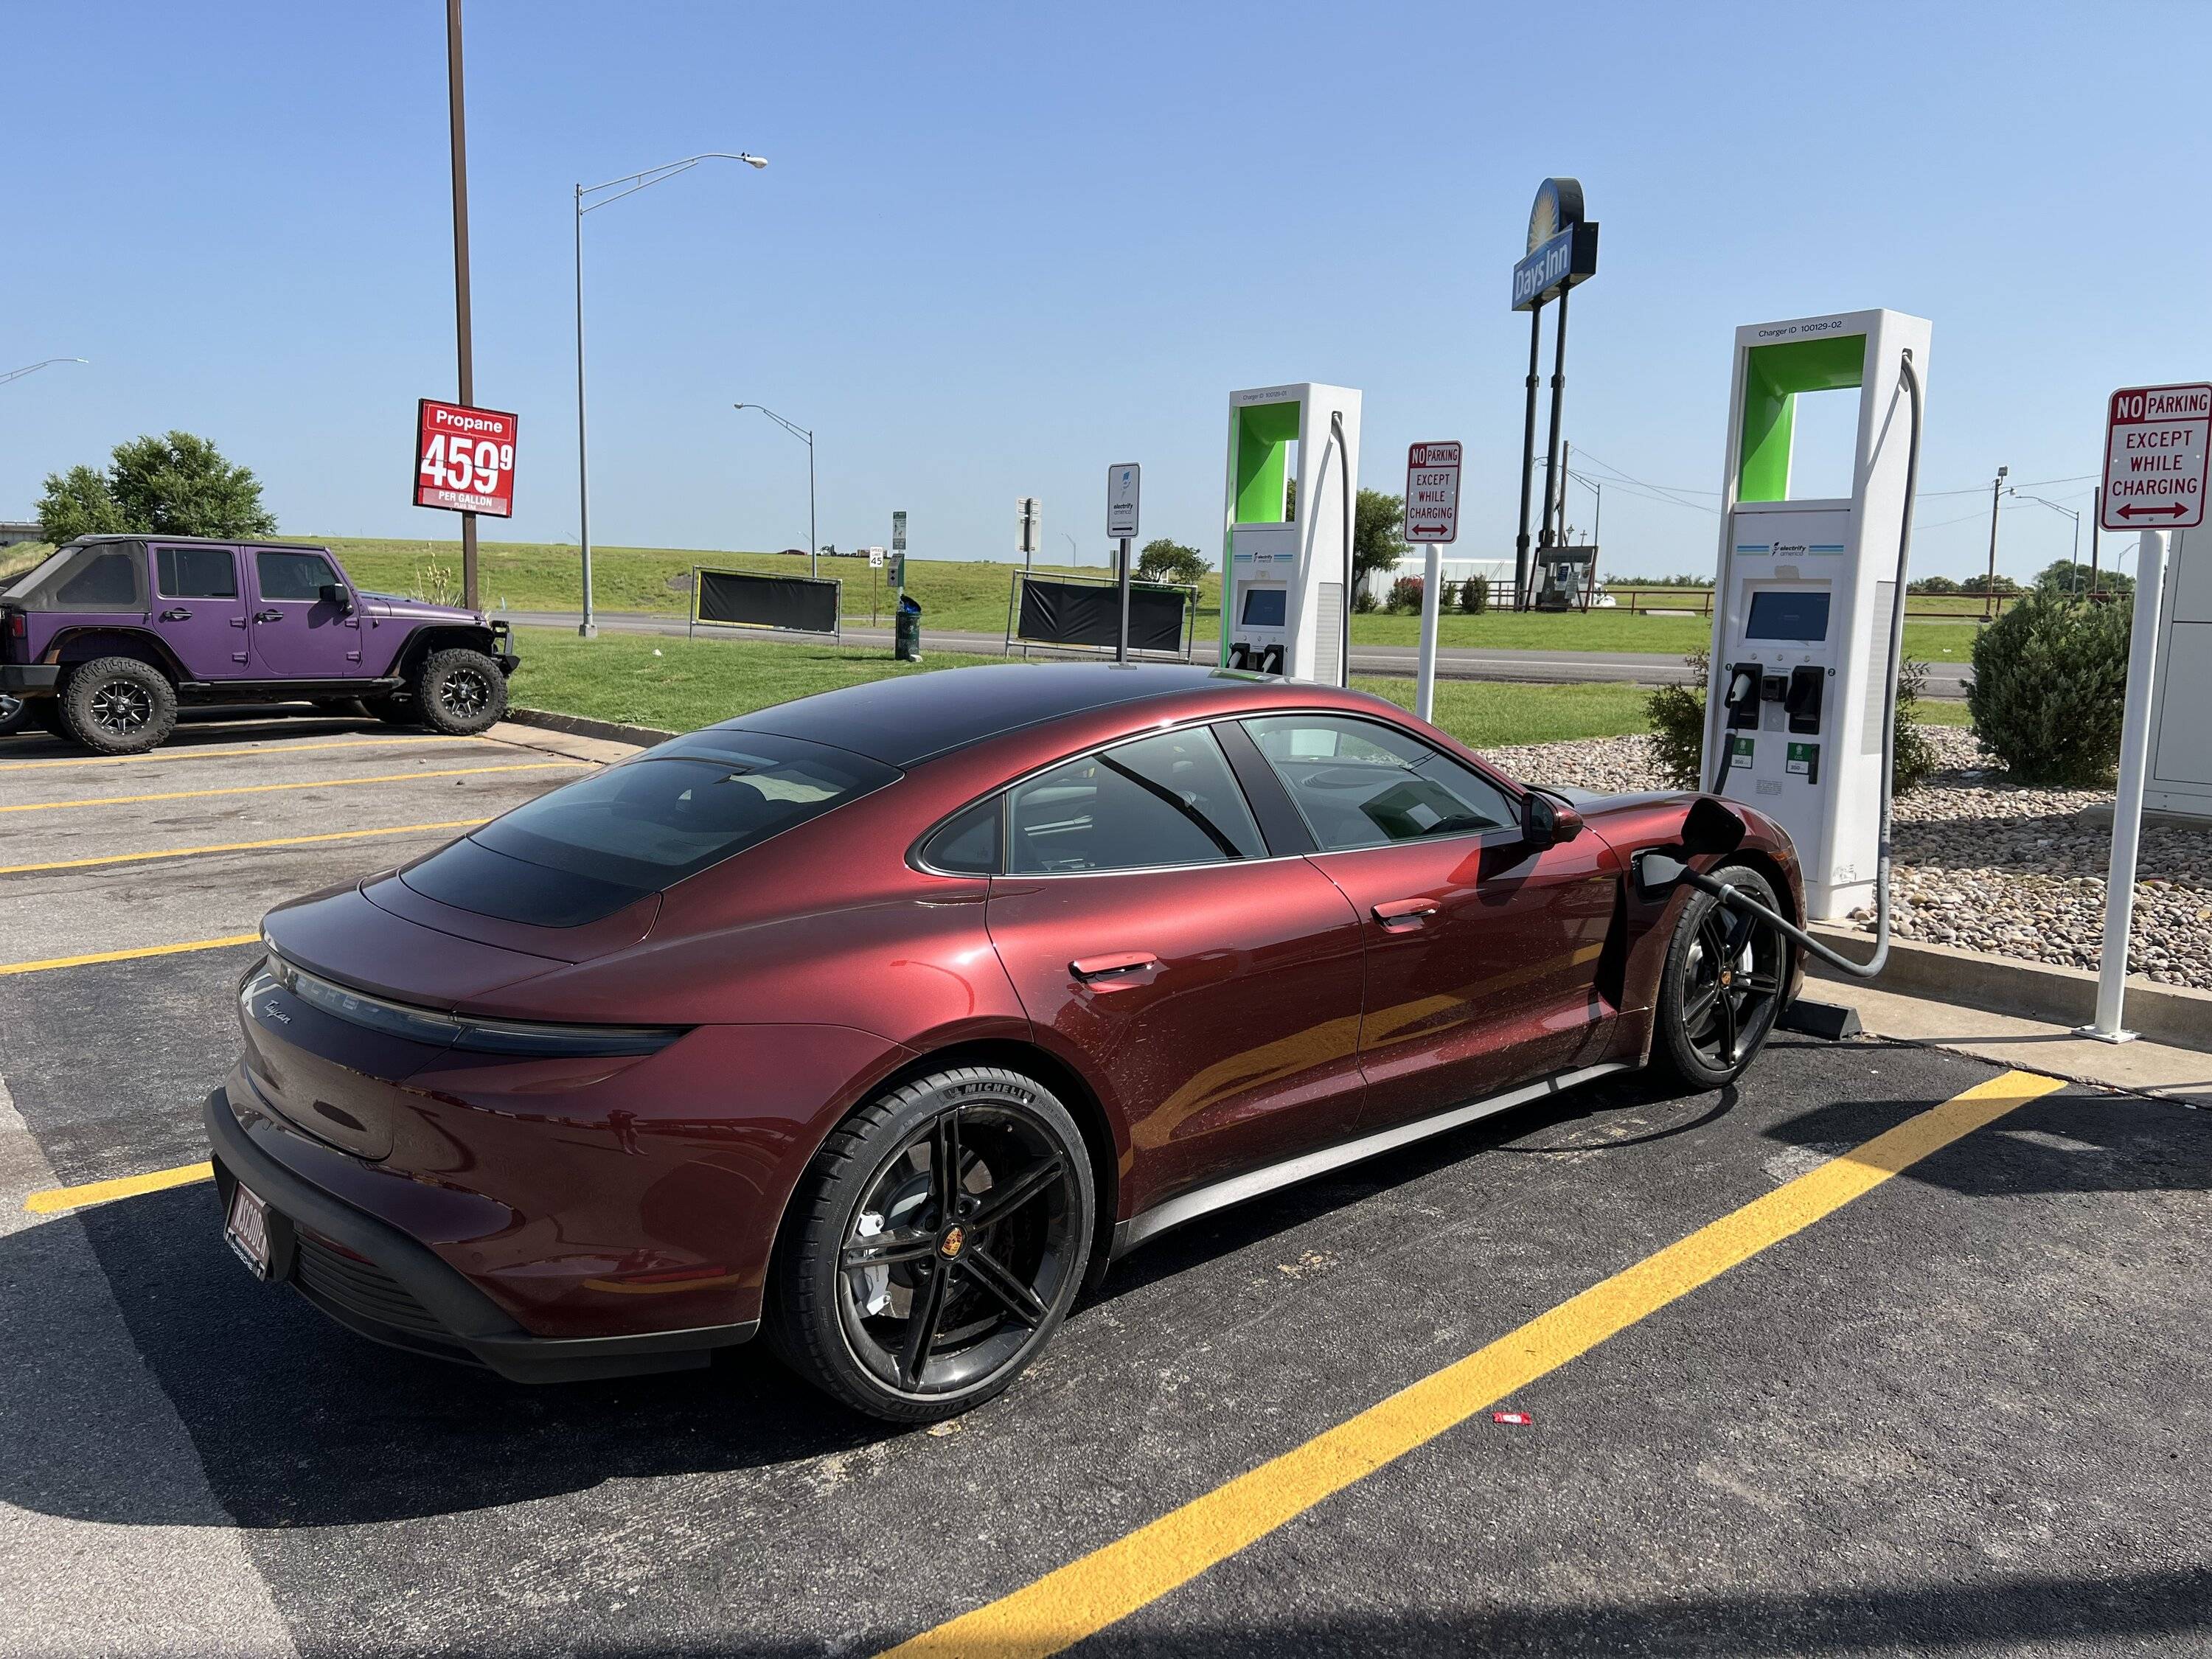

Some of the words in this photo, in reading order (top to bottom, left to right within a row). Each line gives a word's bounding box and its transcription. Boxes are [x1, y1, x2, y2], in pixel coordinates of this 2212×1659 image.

[1515, 260, 1545, 301] Days
[1545, 243, 1568, 280] Inn
[1759, 329, 1787, 338] Charger
[1801, 321, 1843, 332] 100129-02
[2117, 395, 2143, 419] NO
[2148, 394, 2208, 414] PARKING
[436, 409, 503, 433] Propane
[2126, 430, 2193, 449] EXCEPT
[420, 434, 499, 494] 459
[1412, 448, 1425, 464] NO
[1427, 448, 1458, 462] PARKING
[2130, 454, 2183, 472] WHILE
[1416, 473, 1450, 486] EXCEPT
[2112, 478, 2198, 496] CHARGING
[438, 490, 456, 501] PER
[458, 493, 493, 507] GALLON
[1419, 490, 1445, 502] WHILE
[1410, 507, 1453, 519] CHARGING
[871, 557, 883, 566] 45
[264, 999, 292, 1024] Taycan
[964, 1083, 1033, 1101] MICHELIN
